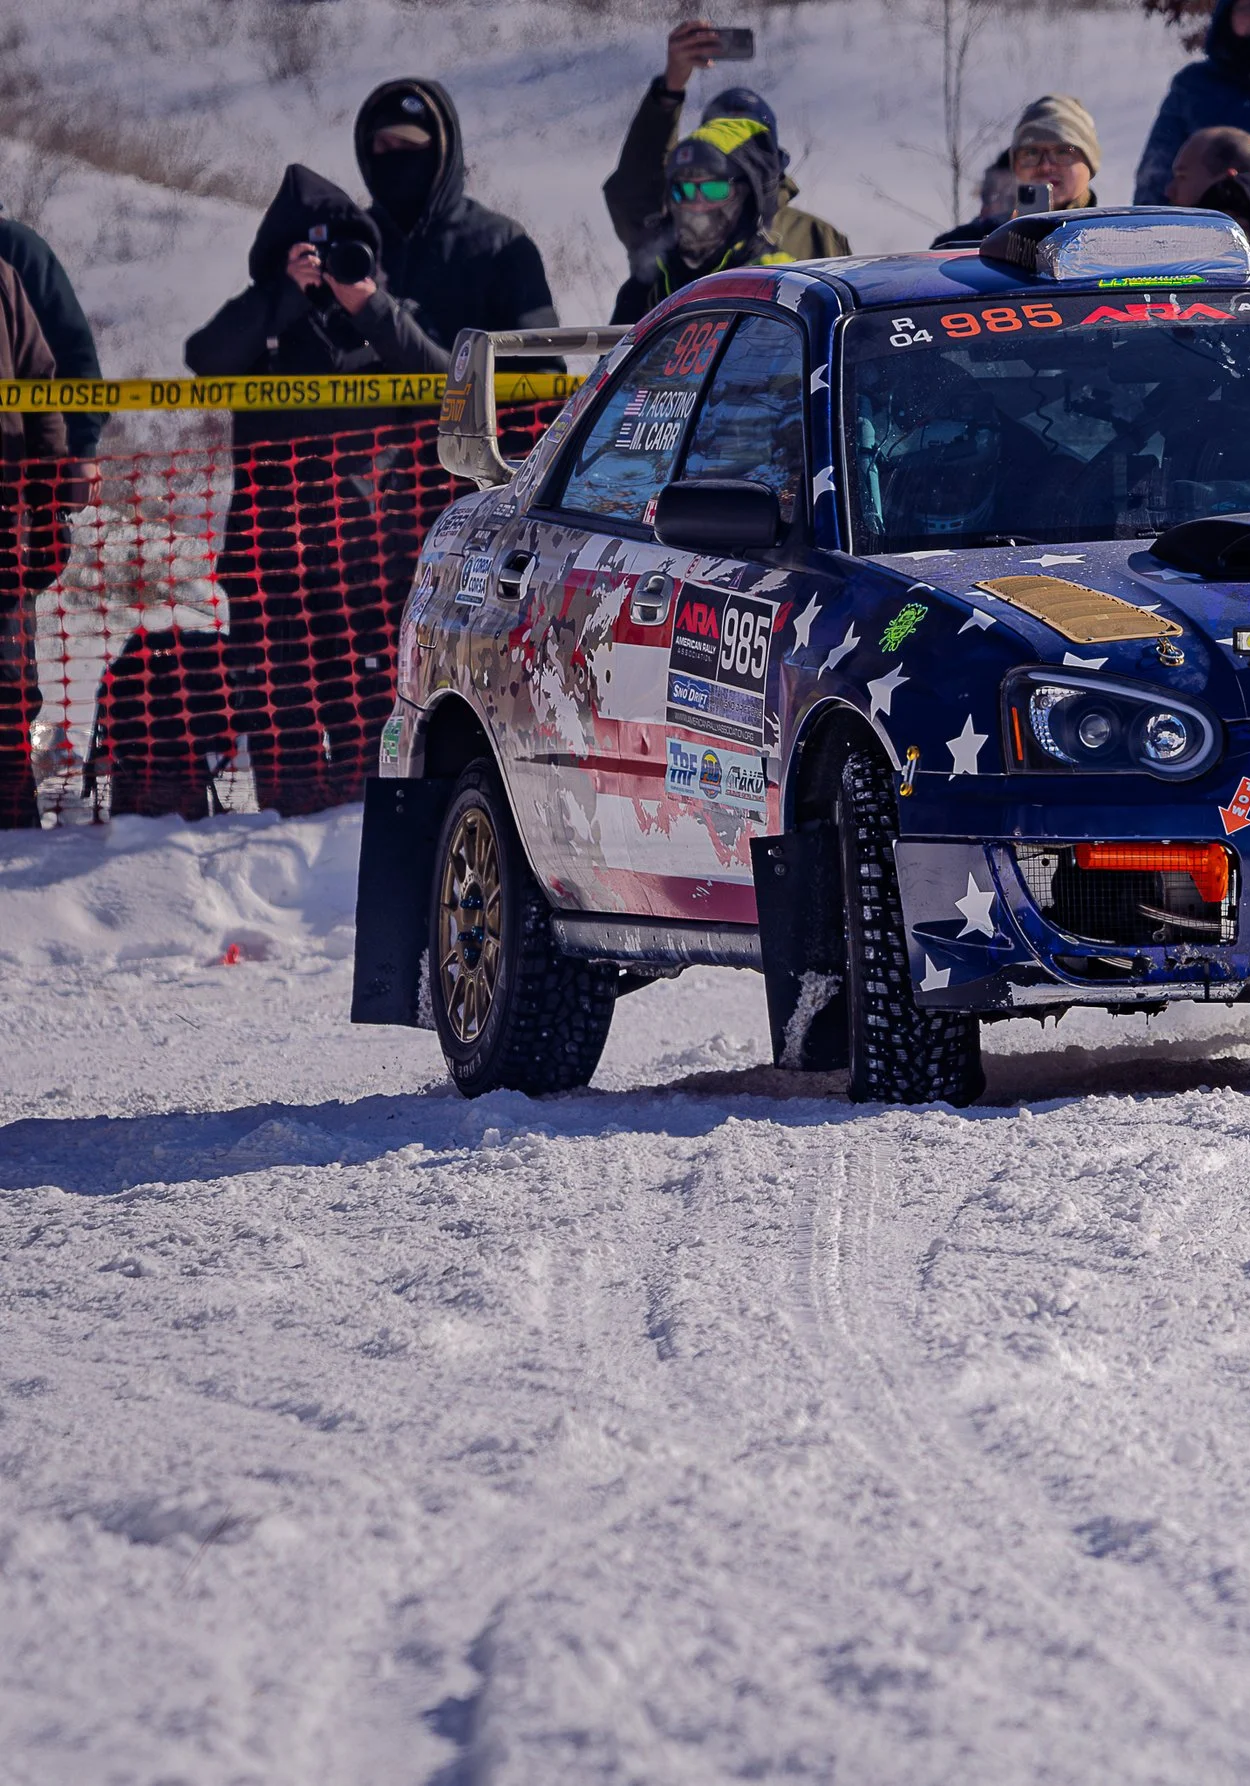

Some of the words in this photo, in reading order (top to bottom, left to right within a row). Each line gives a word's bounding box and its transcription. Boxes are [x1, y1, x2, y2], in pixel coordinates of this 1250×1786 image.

[892, 317, 916, 332] R
[941, 303, 1063, 338] 985
[1080, 303, 1237, 325] ARA
[664, 322, 728, 376] 985
[889, 329, 933, 348] 04
[31, 383, 120, 407] CLOSED
[151, 383, 181, 405] DO
[190, 381, 237, 404] NOT
[245, 380, 320, 404] CROSS
[329, 379, 381, 403] THIS
[389, 377, 447, 400] TAPE
[647, 391, 697, 418] AGOSTINO
[644, 422, 681, 450] CARR
[468, 576, 487, 594] CORSA
[675, 601, 719, 639] ARA
[675, 635, 702, 652] AMERICAN
[702, 640, 717, 655] RALLY
[721, 607, 771, 679] 985
[673, 686, 689, 700] SNO
[688, 689, 708, 706] DRIFT
